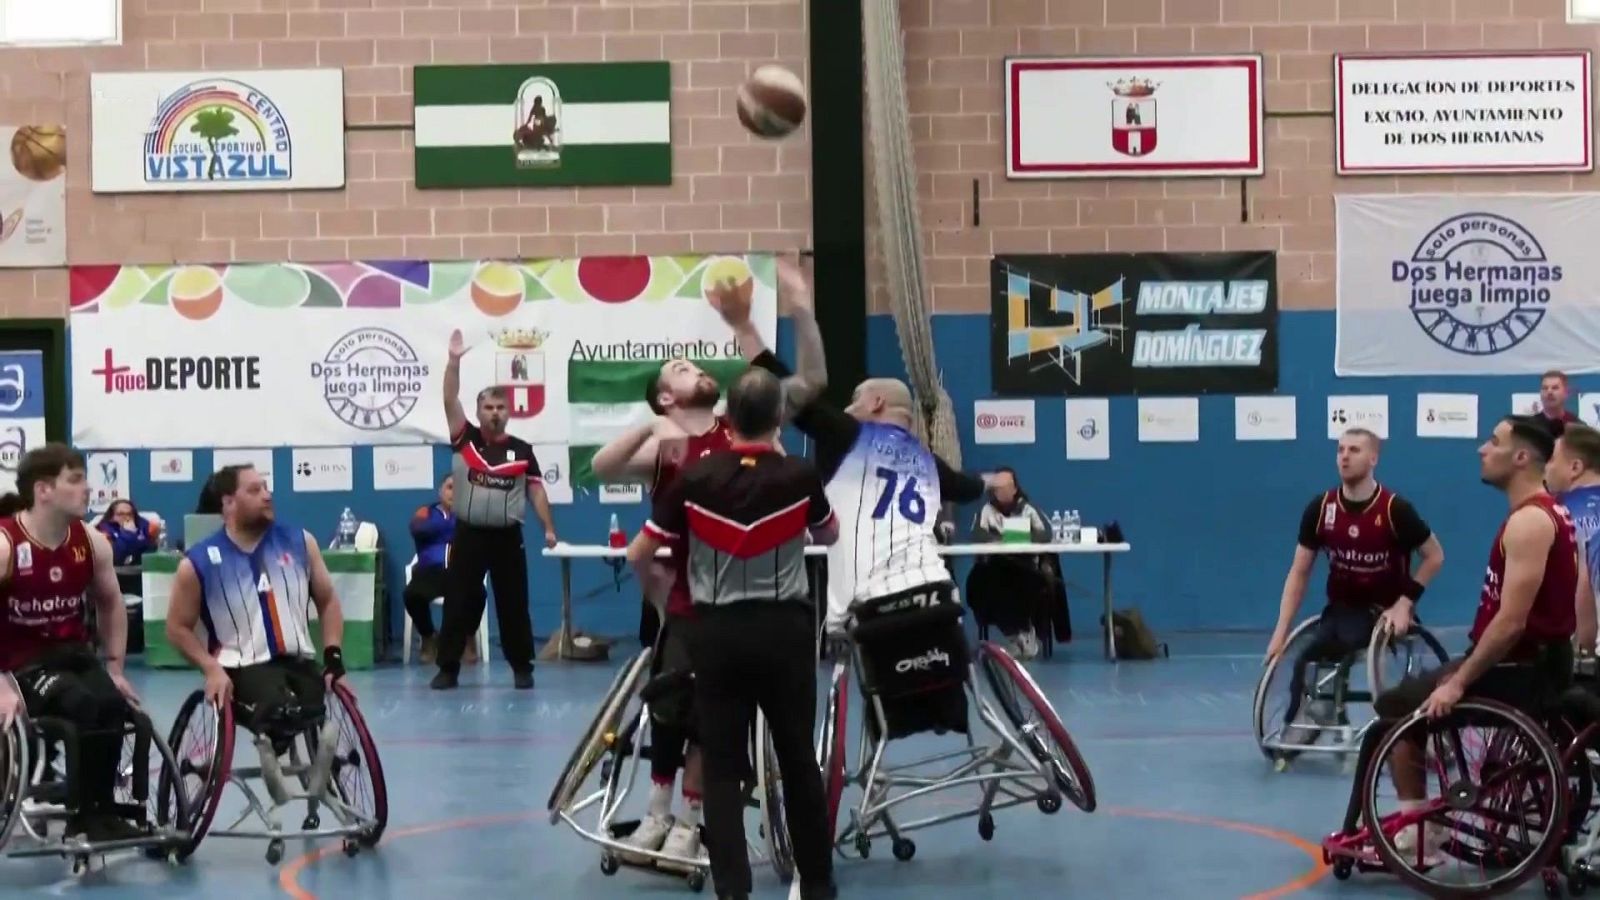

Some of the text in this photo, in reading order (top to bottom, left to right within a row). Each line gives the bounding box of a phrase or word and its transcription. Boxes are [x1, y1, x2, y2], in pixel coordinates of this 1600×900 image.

[1461, 80, 1481, 93] DE
[1487, 79, 1576, 93] DEPORTES
[247, 92, 288, 152] CENTRO
[1364, 108, 1563, 123] EXCMO. AYUNTAMIENTO
[1384, 130, 1544, 145] DE DOS HERMANAS
[148, 154, 288, 179] VISTAZUL
[1426, 219, 1532, 257] solo personas
[1392, 260, 1563, 285] Dos Hermanas
[1136, 281, 1268, 315] MONTAJES
[1409, 280, 1551, 310] juega limpio
[570, 336, 717, 361] Ayuntamiento
[1132, 324, 1267, 368] DOMÍNGUEZ
[311, 361, 429, 380] Dos Hermanas
[372, 378, 422, 397] limpio
[871, 466, 926, 524] 76
